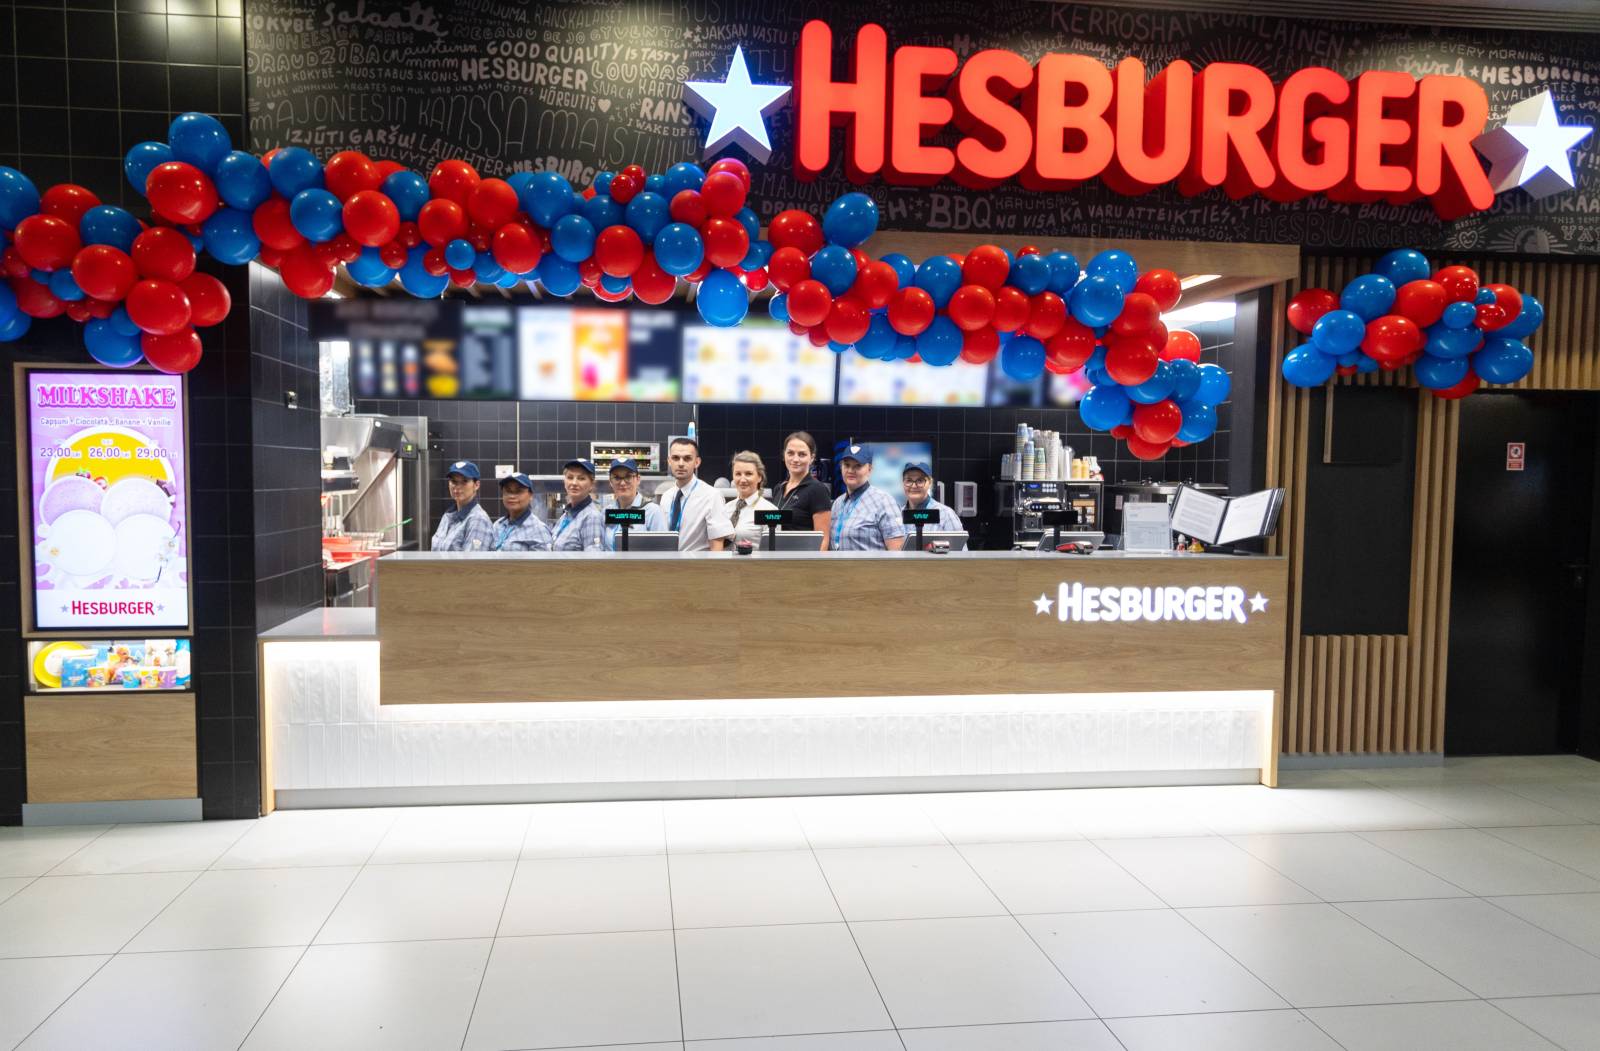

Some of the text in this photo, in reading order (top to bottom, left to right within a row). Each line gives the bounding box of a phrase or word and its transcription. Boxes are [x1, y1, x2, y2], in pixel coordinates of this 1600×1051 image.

[485, 39, 541, 60] GOOD
[544, 42, 625, 65] QUALITY
[624, 50, 638, 61] IS
[1440, 41, 1486, 58] EVERY
[1488, 48, 1545, 62] MORNING
[344, 66, 414, 81] NUOSTABUS
[416, 69, 459, 82] SKONIS
[461, 57, 589, 92] HESBURGER
[1481, 65, 1592, 87] HESBURGER
[591, 80, 634, 99] SNACK
[798, 19, 1495, 212] HESBURGER
[926, 191, 992, 230] BBQ
[1023, 212, 1057, 229] VISA
[38, 385, 176, 408] MILKSHAKE
[71, 600, 155, 615] HESBURGER
[1058, 582, 1248, 624] HESBURGER
